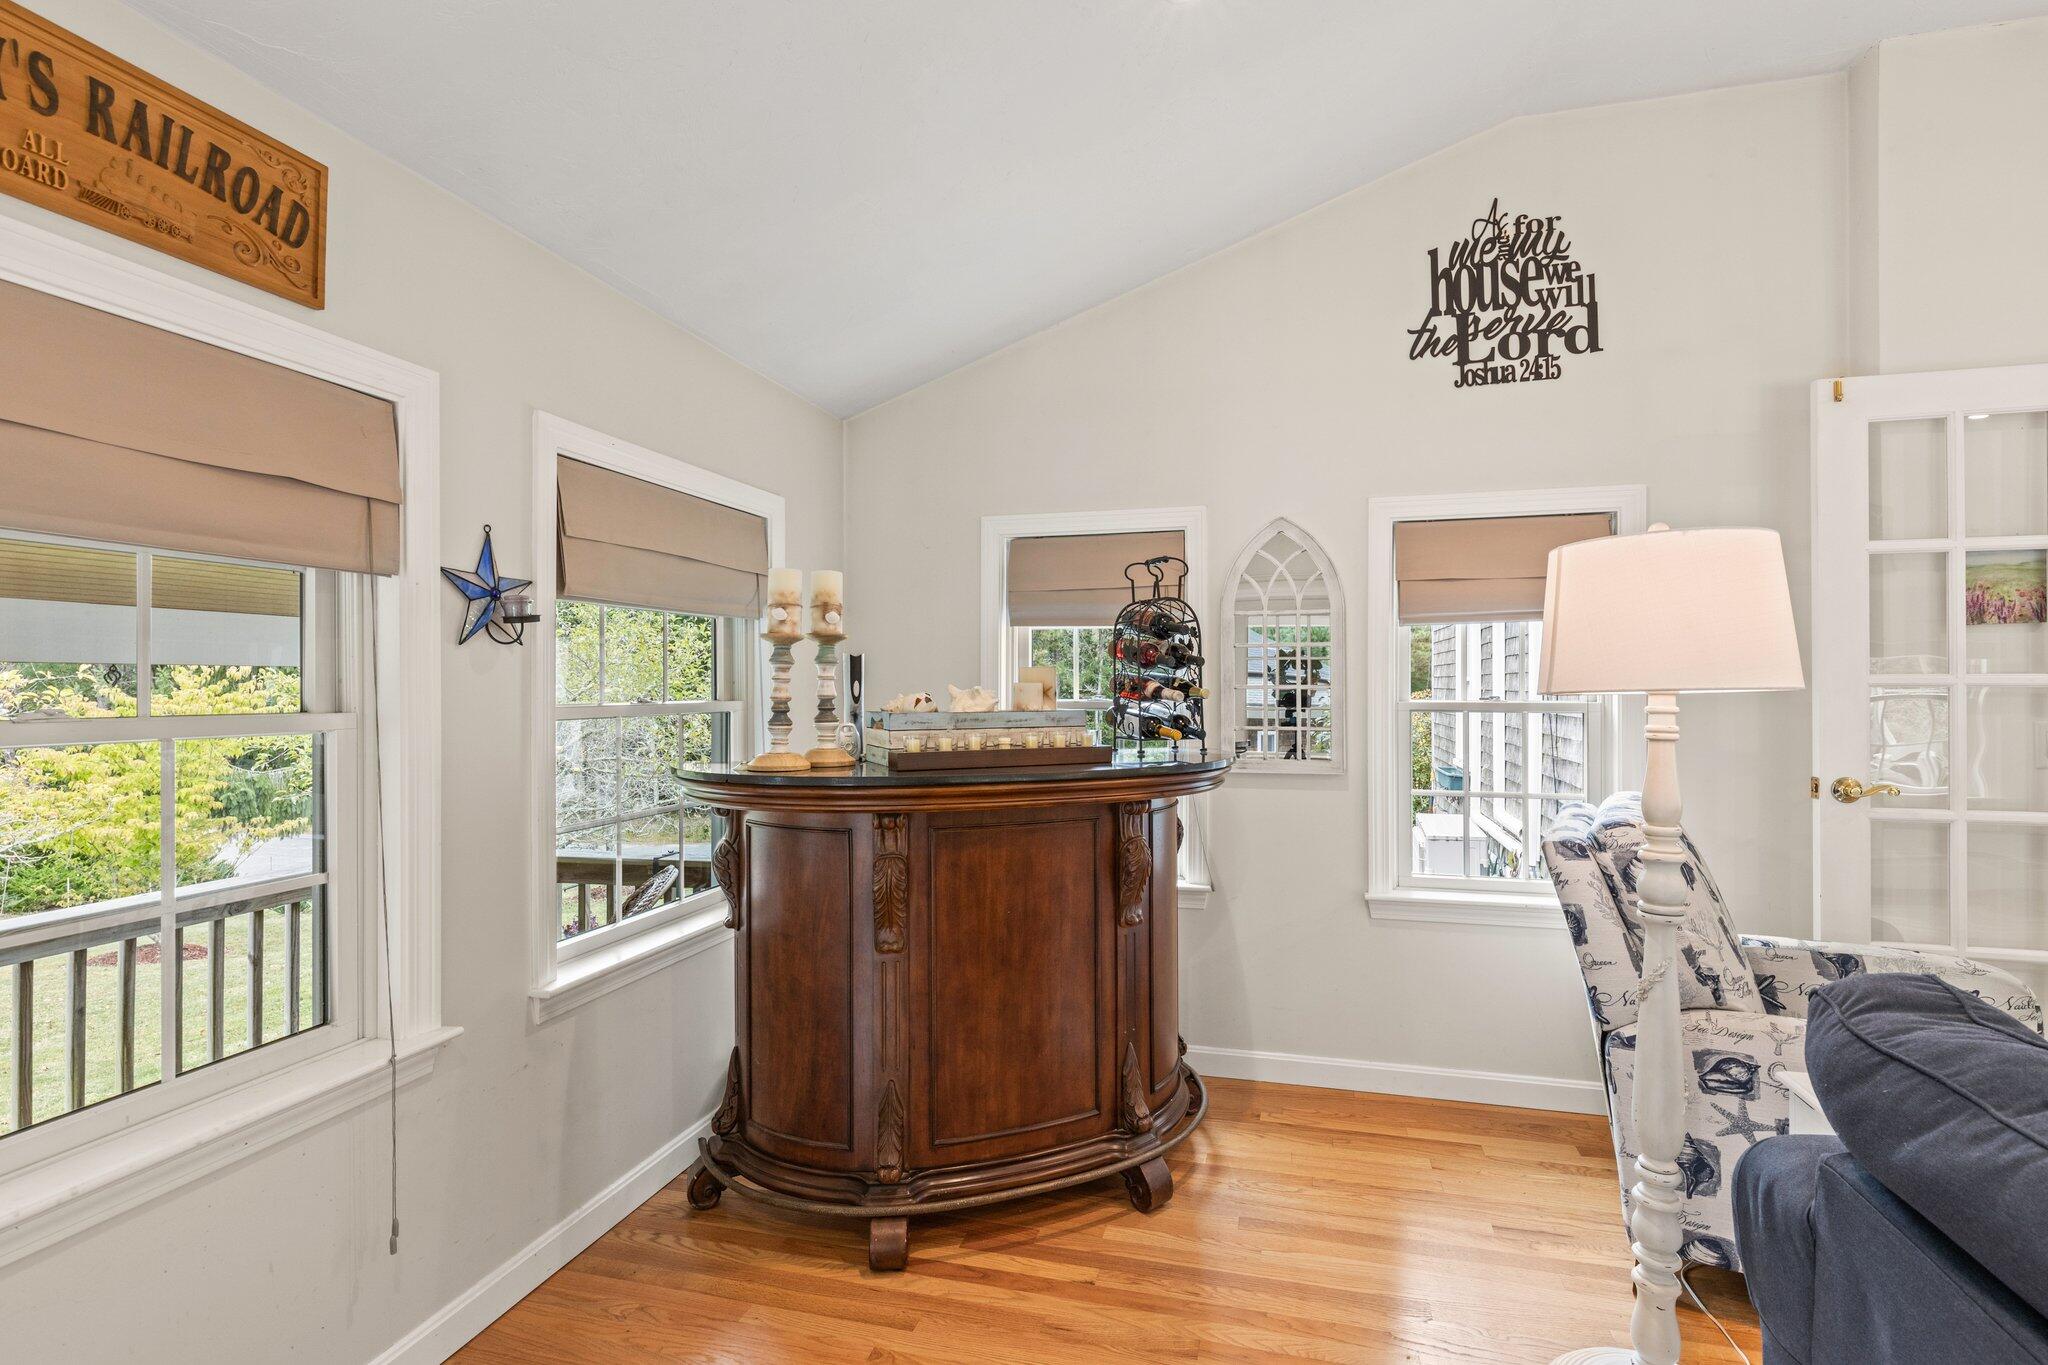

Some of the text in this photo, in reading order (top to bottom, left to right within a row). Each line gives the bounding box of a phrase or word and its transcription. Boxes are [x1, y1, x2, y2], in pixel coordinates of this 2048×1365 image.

[22, 128, 70, 167] ALL
[86, 76, 310, 249] RAILROAD
[1513, 214, 1562, 235] for
[1449, 236, 1500, 269] me
[1508, 230, 1572, 264] my
[1427, 247, 1581, 317] house we
[1534, 273, 1596, 310] will
[1407, 301, 1604, 366] the Lord
[1465, 305, 1574, 341] serve
[1454, 355, 1562, 388] Joshua 24:15
[1711, 1026, 1755, 1046] Design
